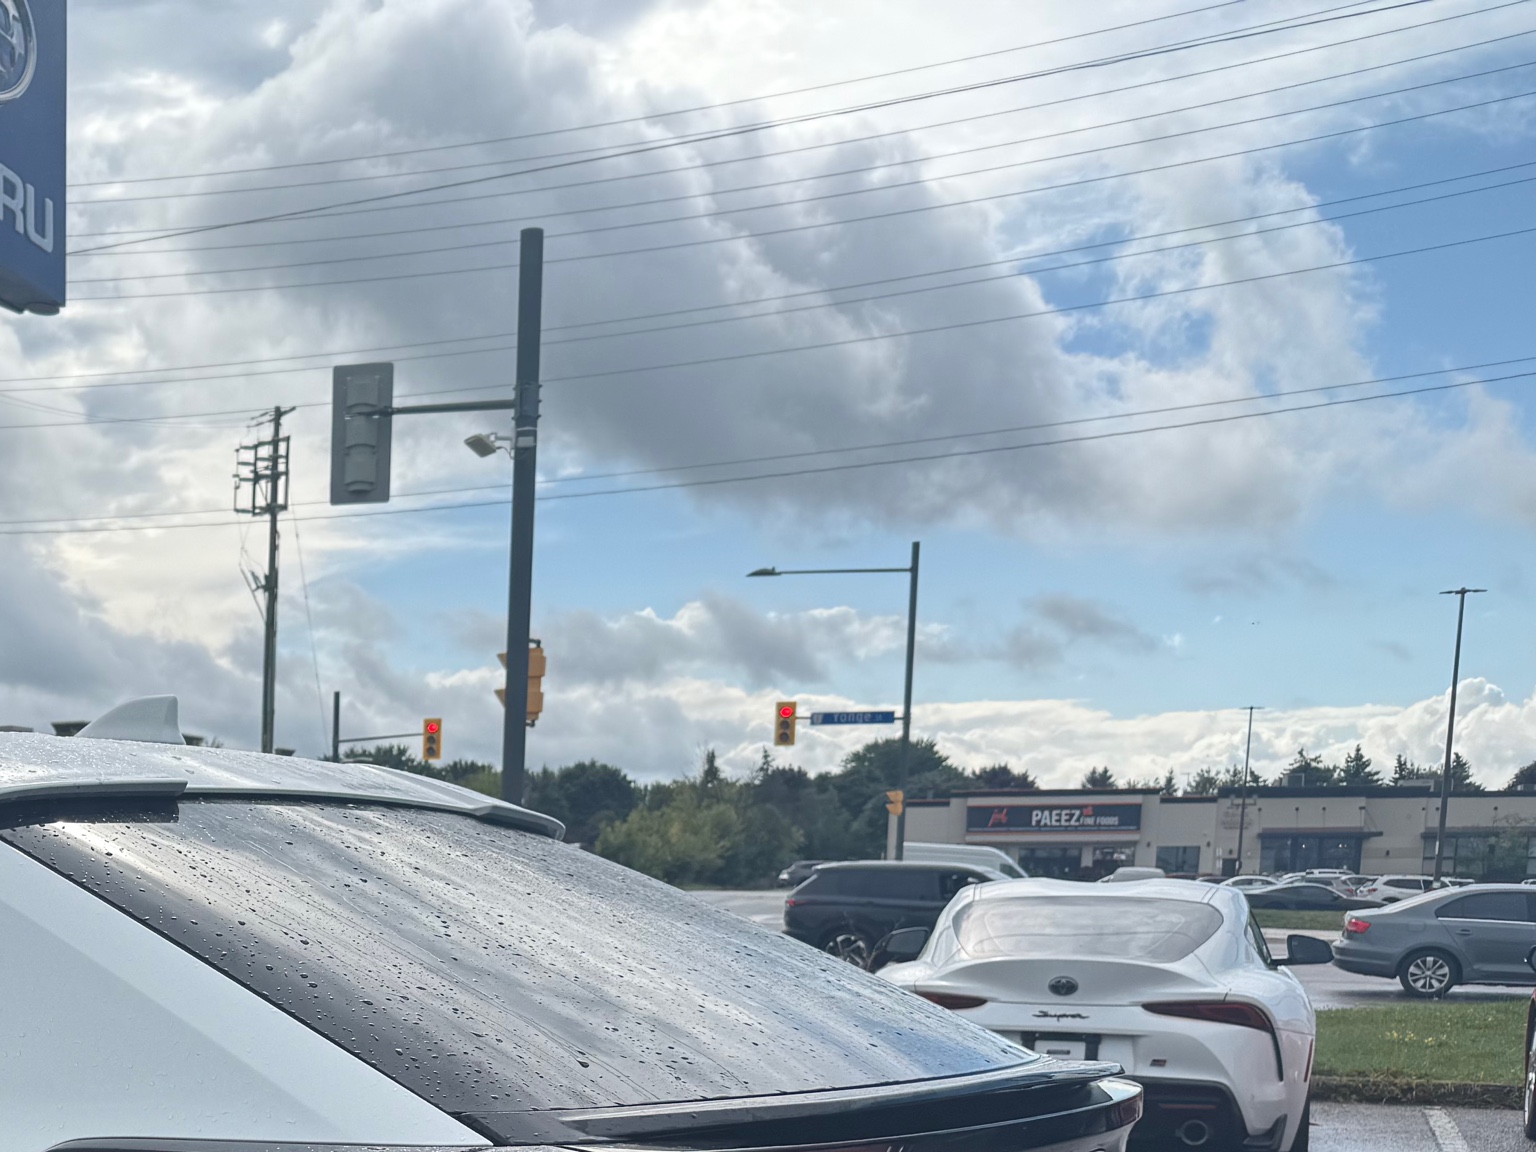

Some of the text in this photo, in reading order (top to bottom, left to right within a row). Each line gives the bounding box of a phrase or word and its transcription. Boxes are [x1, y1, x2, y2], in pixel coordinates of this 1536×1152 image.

[833, 713, 872, 723] Yonge
[1031, 809, 1119, 826] PAEEZ FINE FOODS
[1032, 1010, 1090, 1022] Supra
